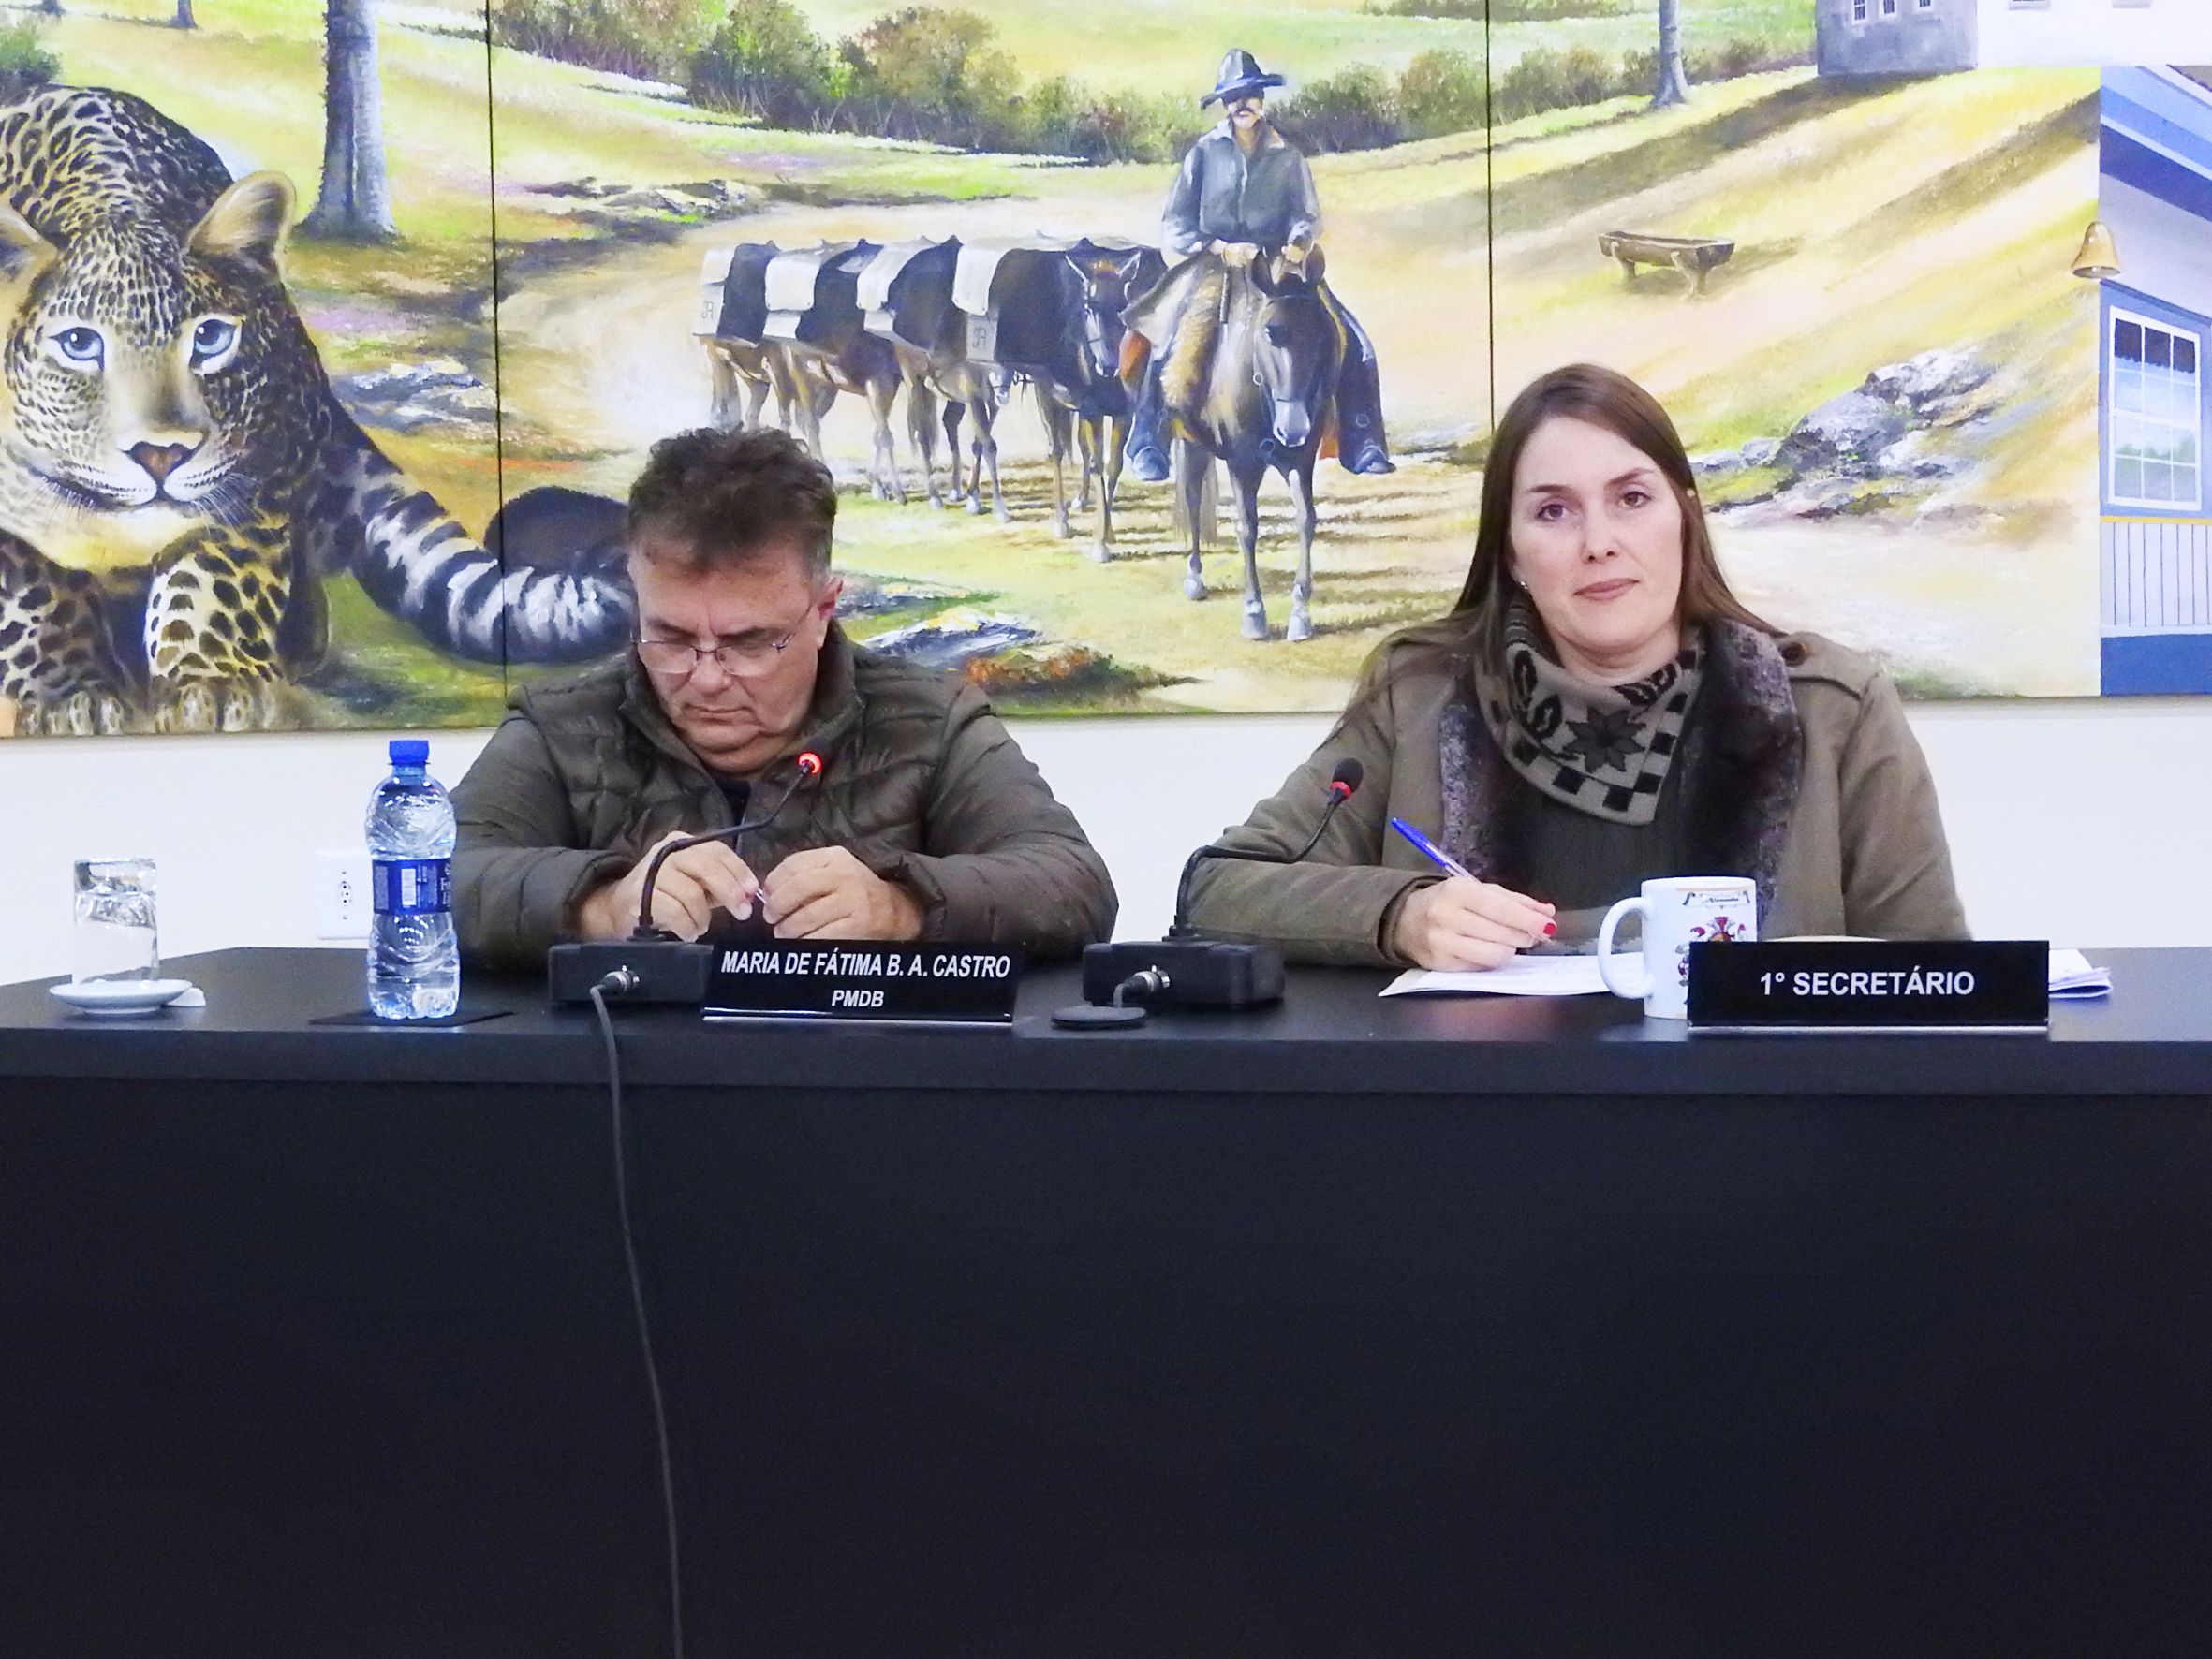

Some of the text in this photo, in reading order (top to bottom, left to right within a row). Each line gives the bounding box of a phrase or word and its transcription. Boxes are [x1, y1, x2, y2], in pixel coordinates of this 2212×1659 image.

[720, 947, 1011, 978] MARIA DE FÁTIMA B. A. CASTRO
[1792, 964, 1975, 996] SECRETÁRIO
[831, 989, 885, 1008] PMDB
